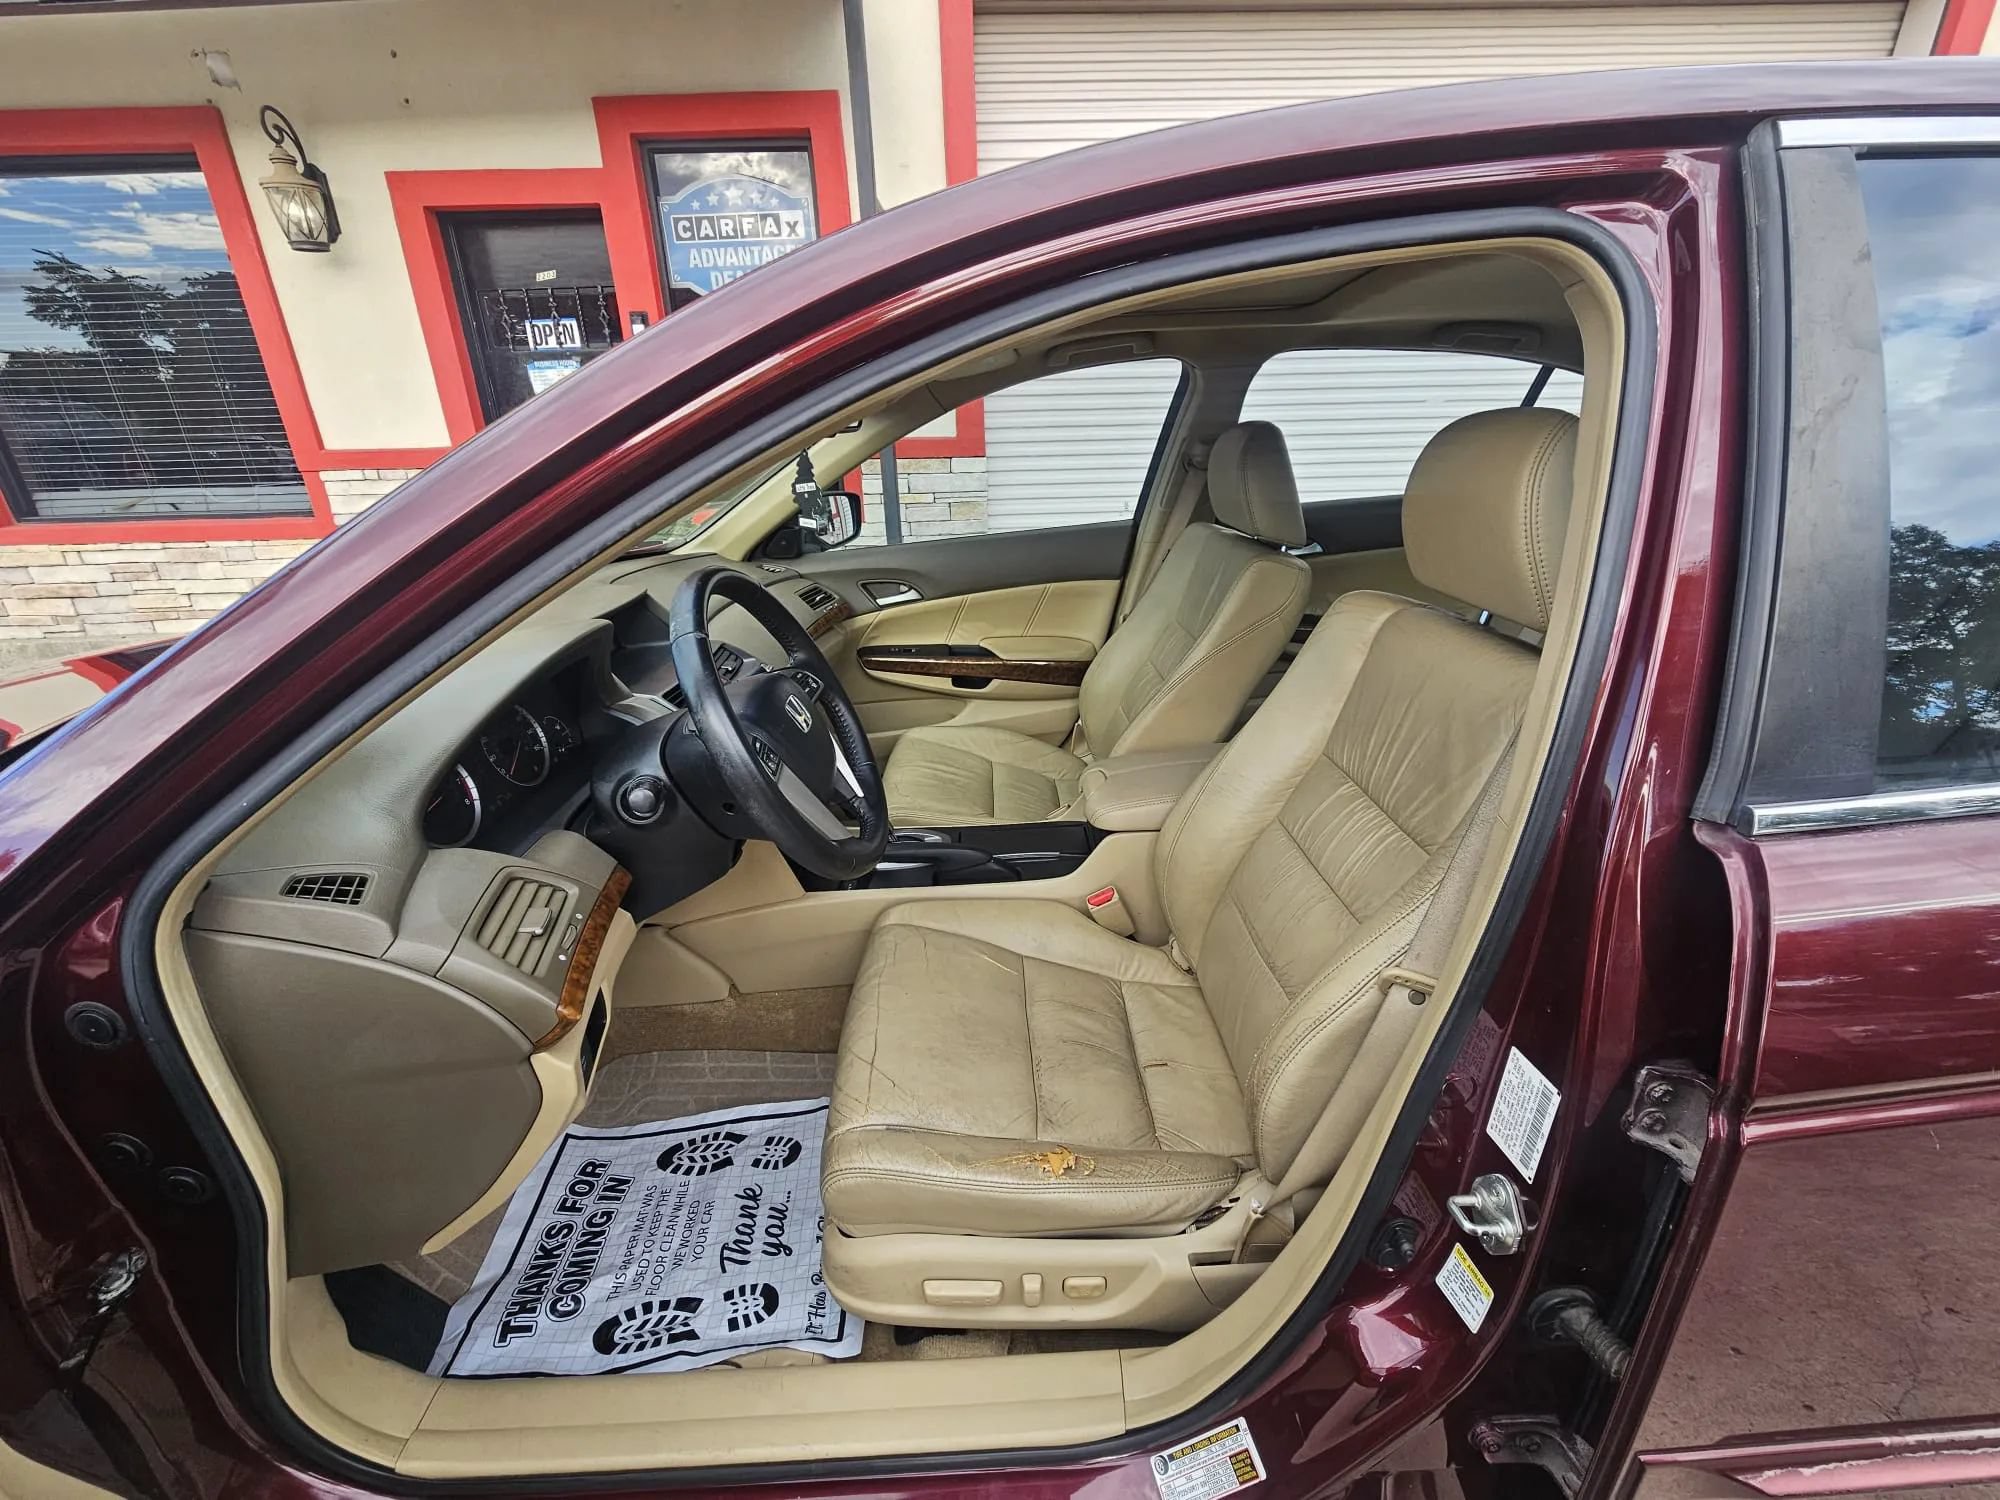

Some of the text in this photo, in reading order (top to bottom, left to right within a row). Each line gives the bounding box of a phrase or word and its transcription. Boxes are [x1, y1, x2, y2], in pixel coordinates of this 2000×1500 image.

[677, 216, 800, 239] CARFAX
[531, 323, 576, 347] OPEN
[493, 1158, 612, 1348] THANKS FOR
[545, 1175, 635, 1322] COMING IN
[606, 1184, 658, 1302] THIS PAPER MAT WAS
[628, 1187, 672, 1292] USED TO KEEP THE
[645, 1179, 691, 1297] FLOOR CLEAN WHILE
[671, 1200, 701, 1272] WE WORKED
[690, 1200, 716, 1263] YOUR CAR
[719, 1183, 763, 1274] Thank
[808, 1291, 827, 1319] Has
